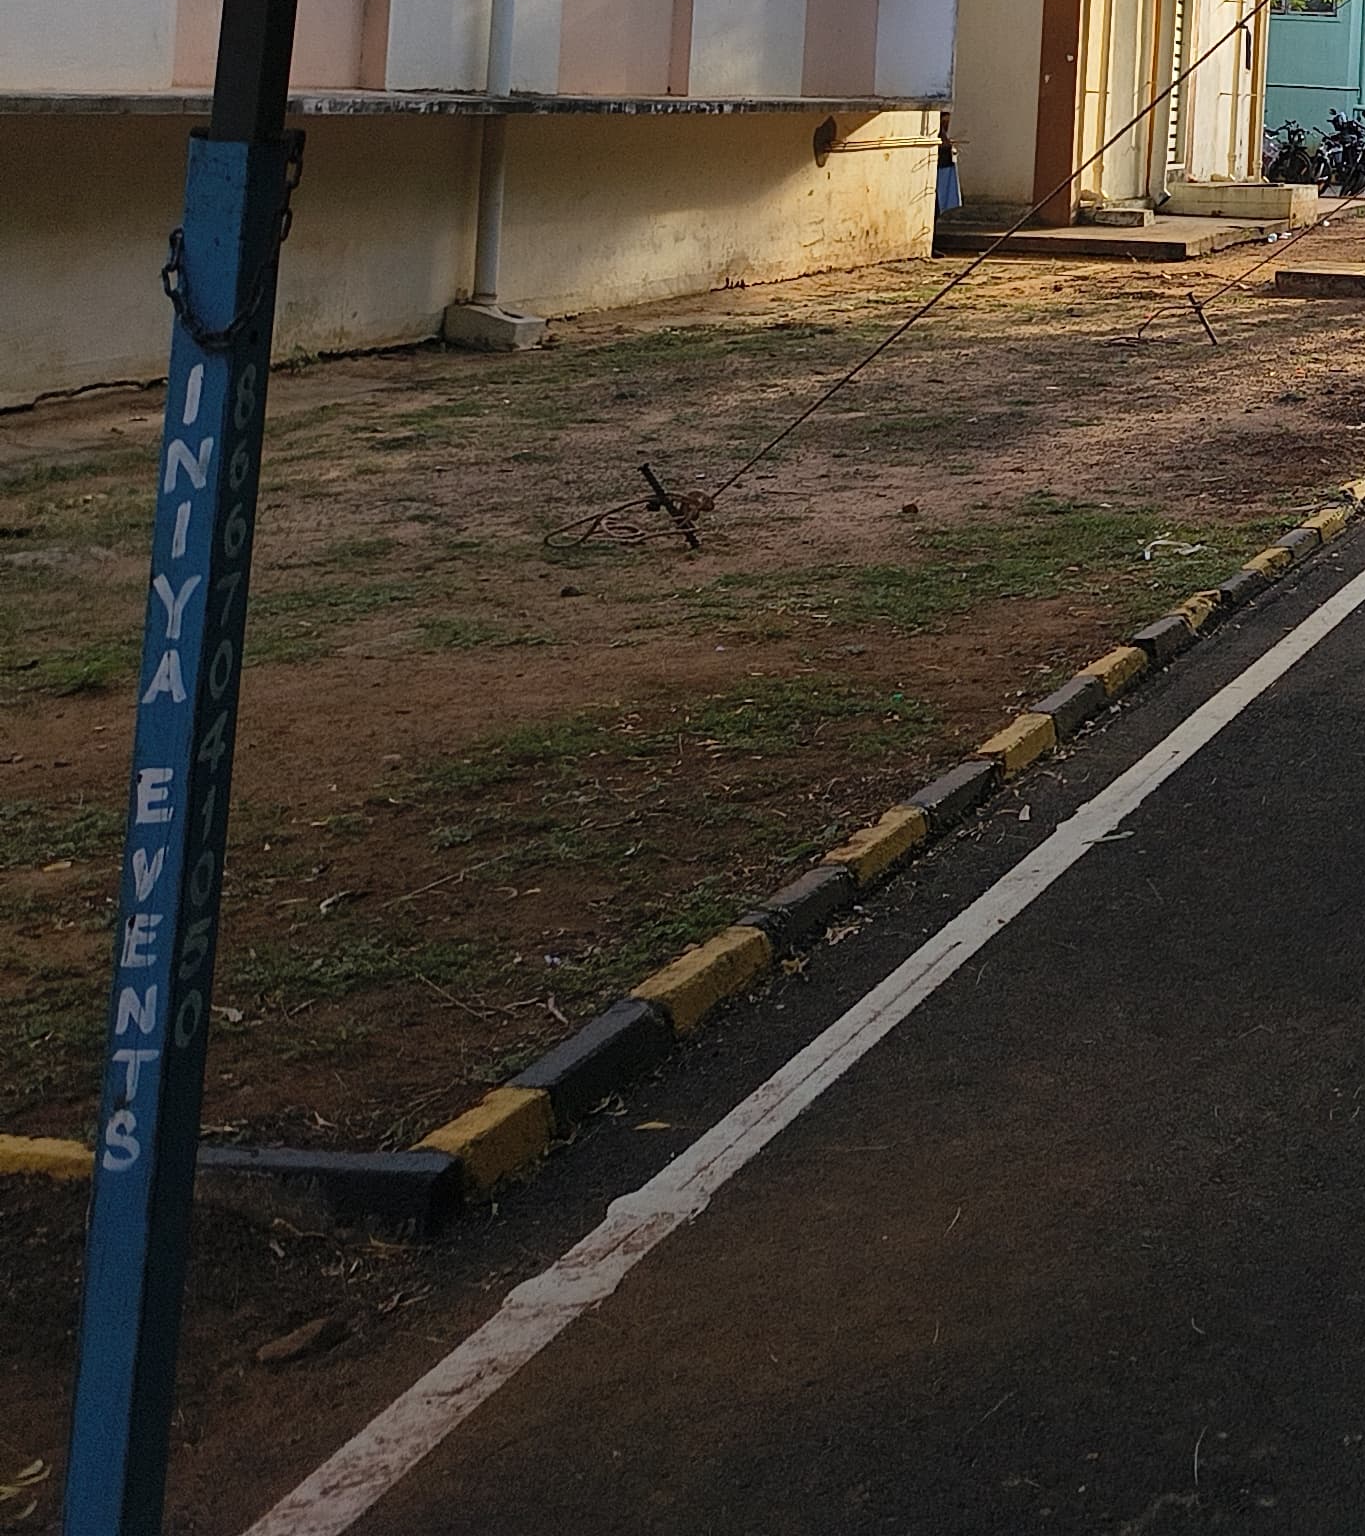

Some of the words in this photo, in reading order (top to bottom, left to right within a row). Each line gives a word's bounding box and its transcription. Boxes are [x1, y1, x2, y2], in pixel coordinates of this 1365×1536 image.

[142, 363, 214, 705] INIYA
[176, 362, 258, 1048] 8667041050
[102, 768, 174, 1174] EVENTS
